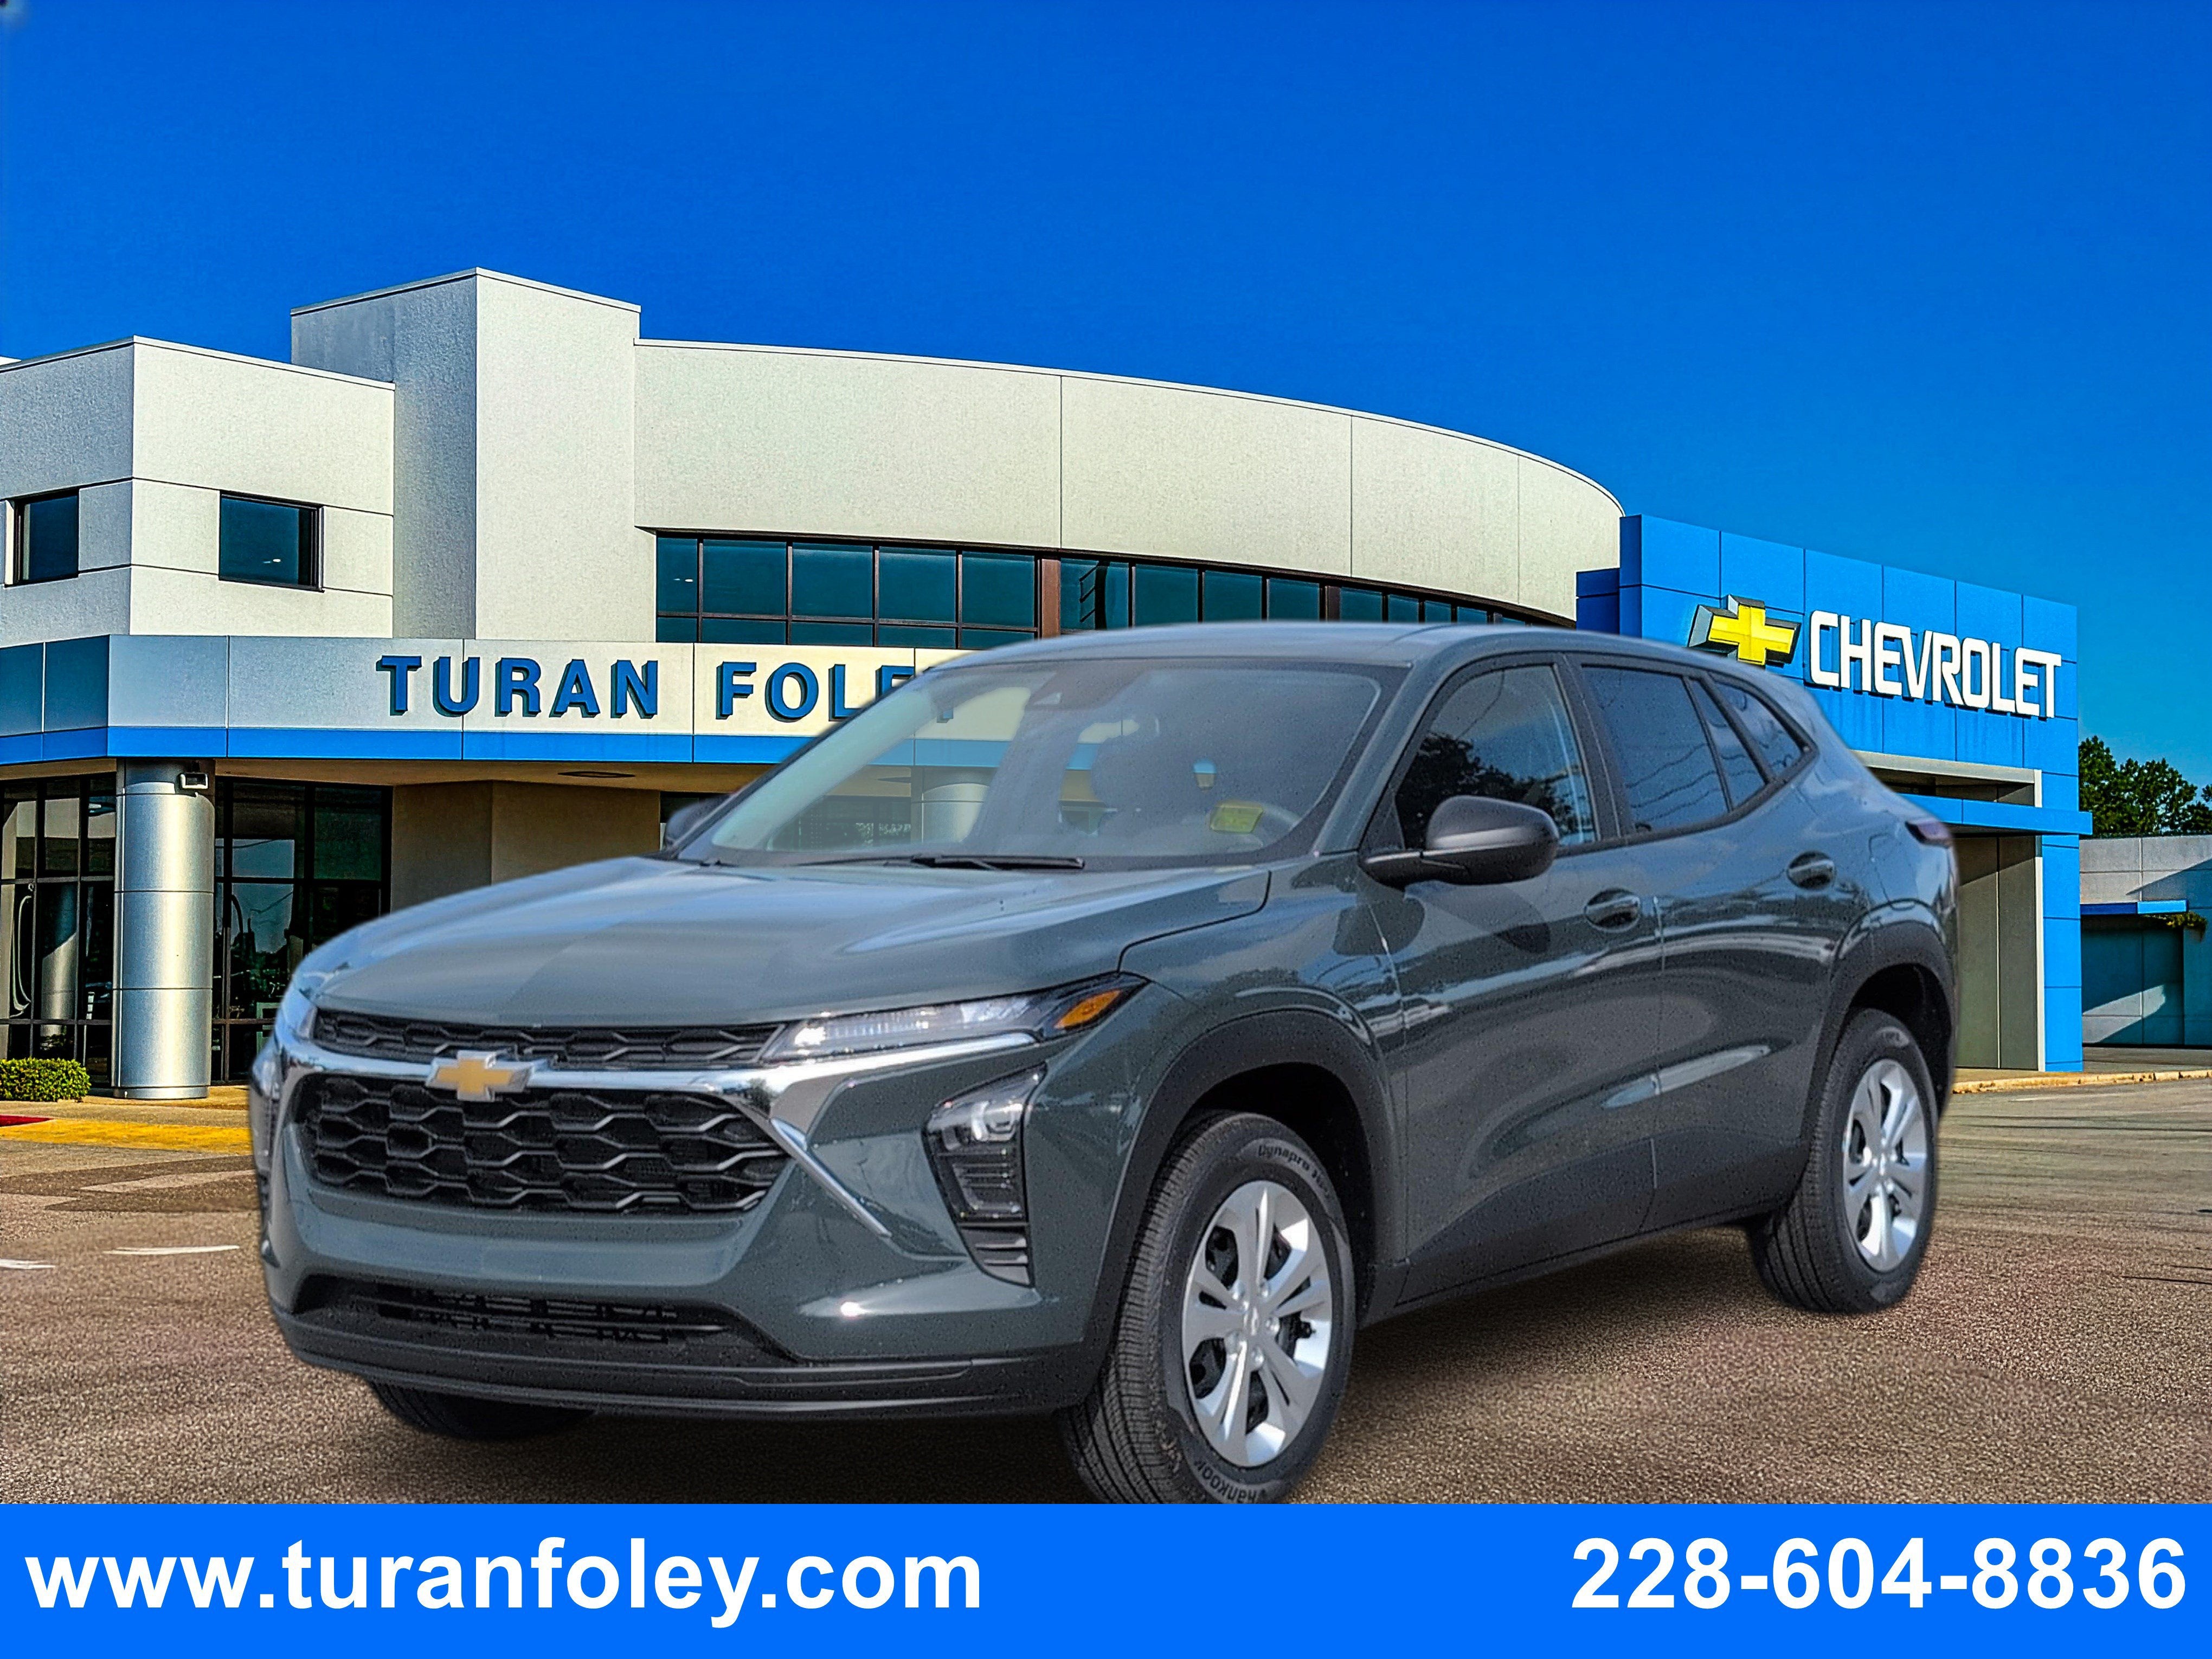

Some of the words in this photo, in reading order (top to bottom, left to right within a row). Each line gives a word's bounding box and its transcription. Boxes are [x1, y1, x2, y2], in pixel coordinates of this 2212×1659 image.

[375, 655, 658, 718] TURAN
[716, 661, 954, 723] FOL
[1809, 610, 2062, 718] CHEVROLET
